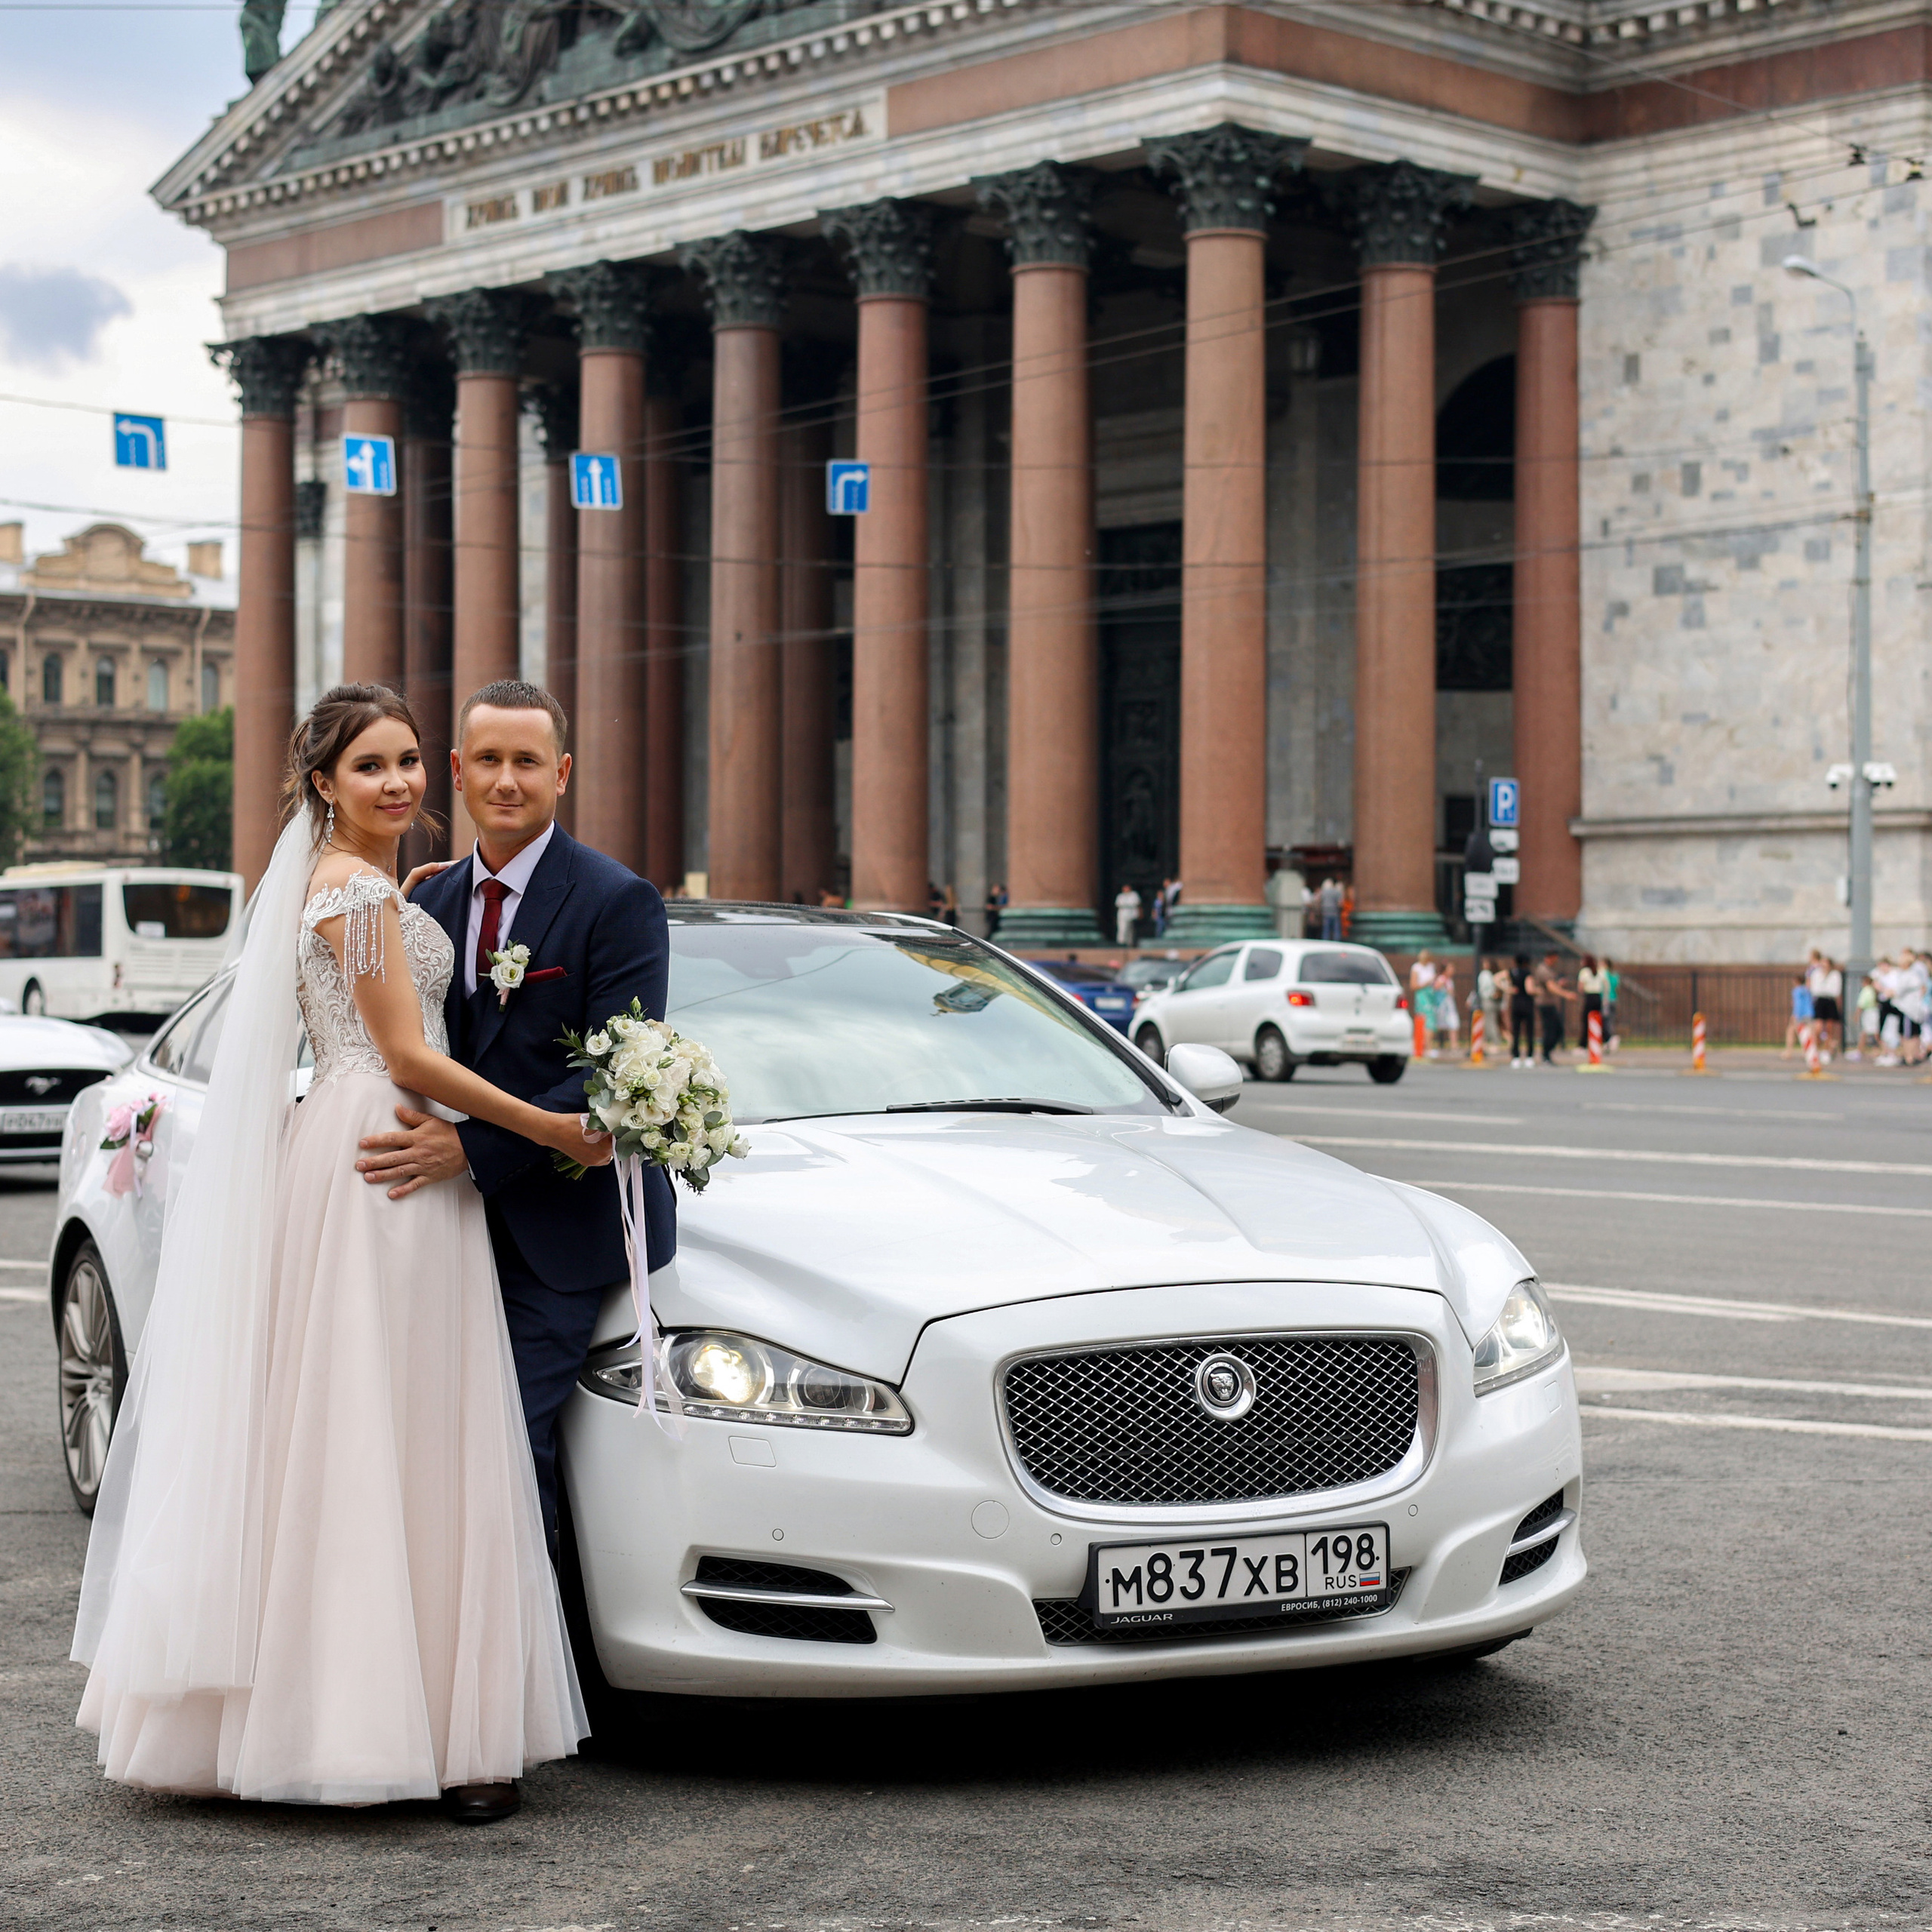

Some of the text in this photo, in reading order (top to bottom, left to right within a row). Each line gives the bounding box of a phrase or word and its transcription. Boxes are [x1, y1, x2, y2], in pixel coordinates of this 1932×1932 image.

[1497, 785, 1514, 820] P
[1112, 1533, 1375, 1607] М837ХВ 198
[1324, 1574, 1357, 1590] RUS
[1281, 1594, 1378, 1612] ЕВРОСИБ, (812) 240-1000
[1110, 1614, 1174, 1624] JAGUAR
